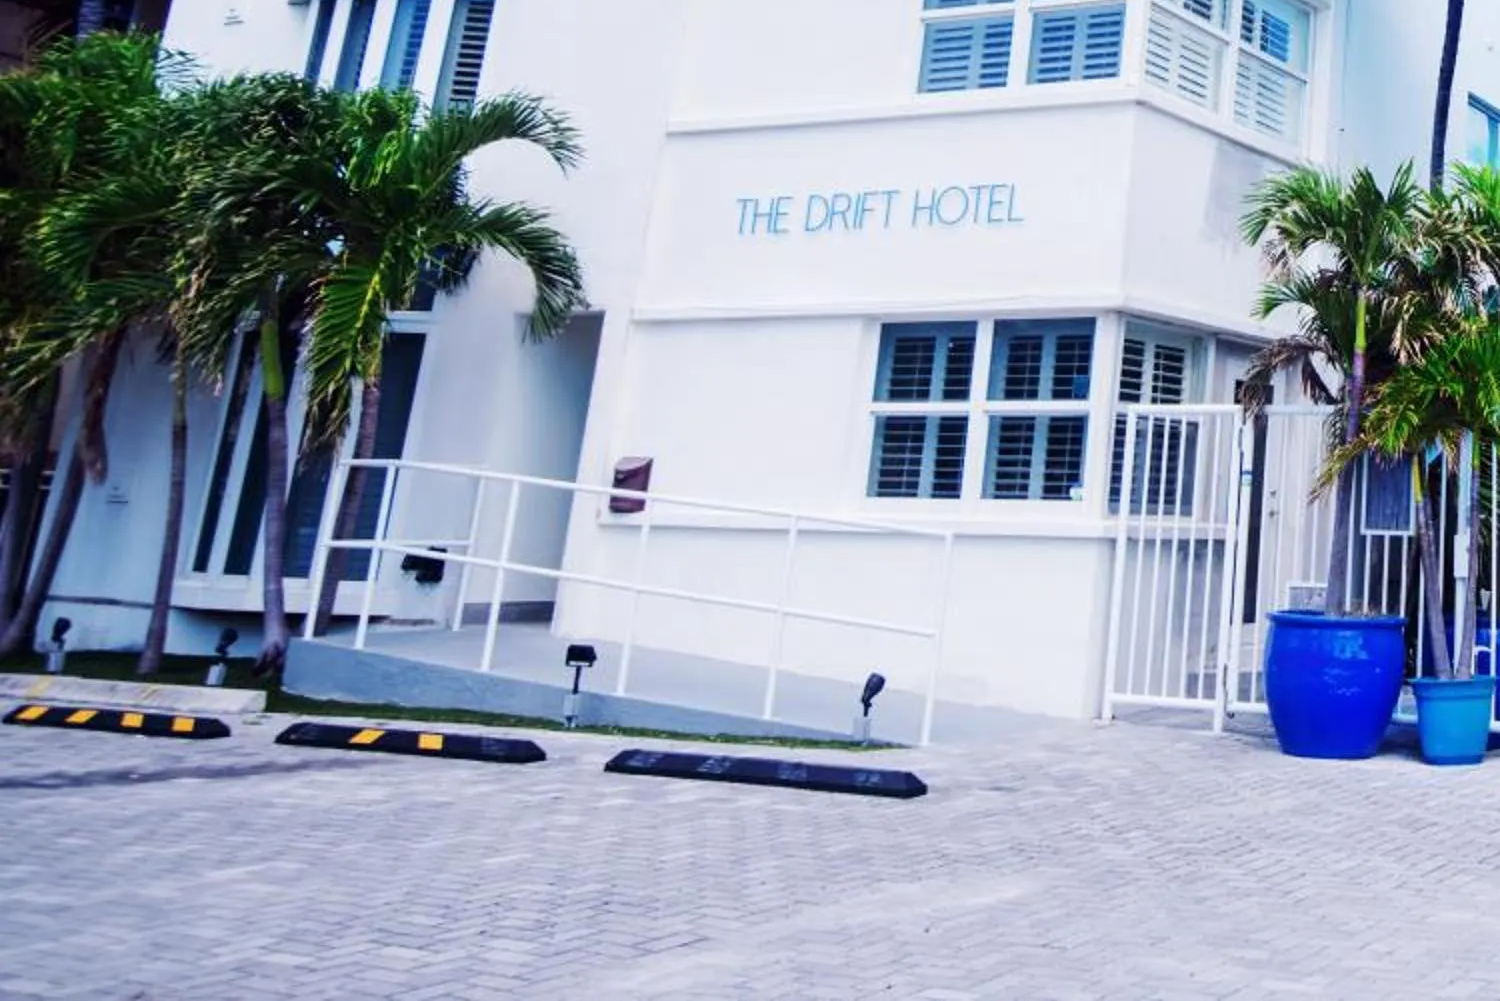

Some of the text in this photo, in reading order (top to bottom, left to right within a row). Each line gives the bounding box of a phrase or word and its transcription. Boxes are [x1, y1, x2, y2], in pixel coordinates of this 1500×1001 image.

[736, 183, 1025, 235] THE DRIFT HOTEL
